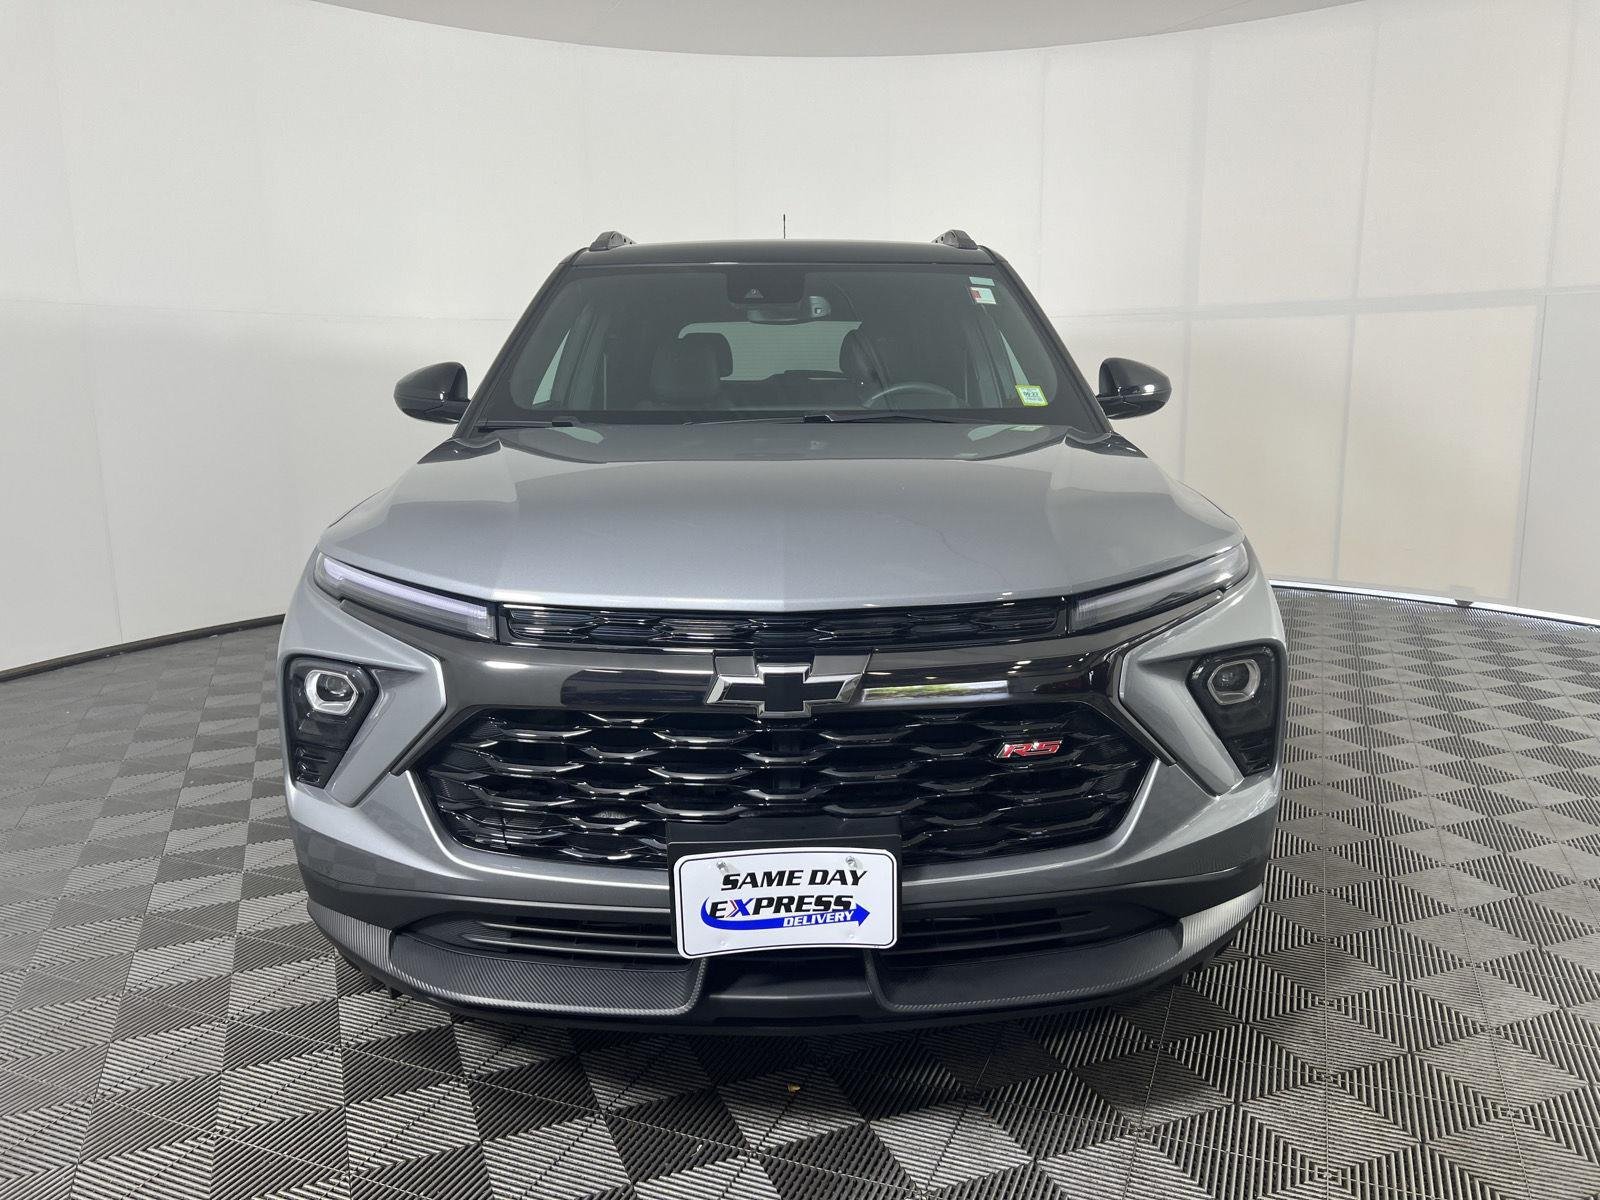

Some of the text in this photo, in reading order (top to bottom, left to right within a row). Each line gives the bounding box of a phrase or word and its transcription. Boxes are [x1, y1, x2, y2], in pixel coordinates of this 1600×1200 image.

[997, 740, 1062, 758] RS
[721, 869, 868, 891] SAME DAY
[709, 894, 854, 919] EXPRESS
[782, 910, 856, 928] DELIVERY
